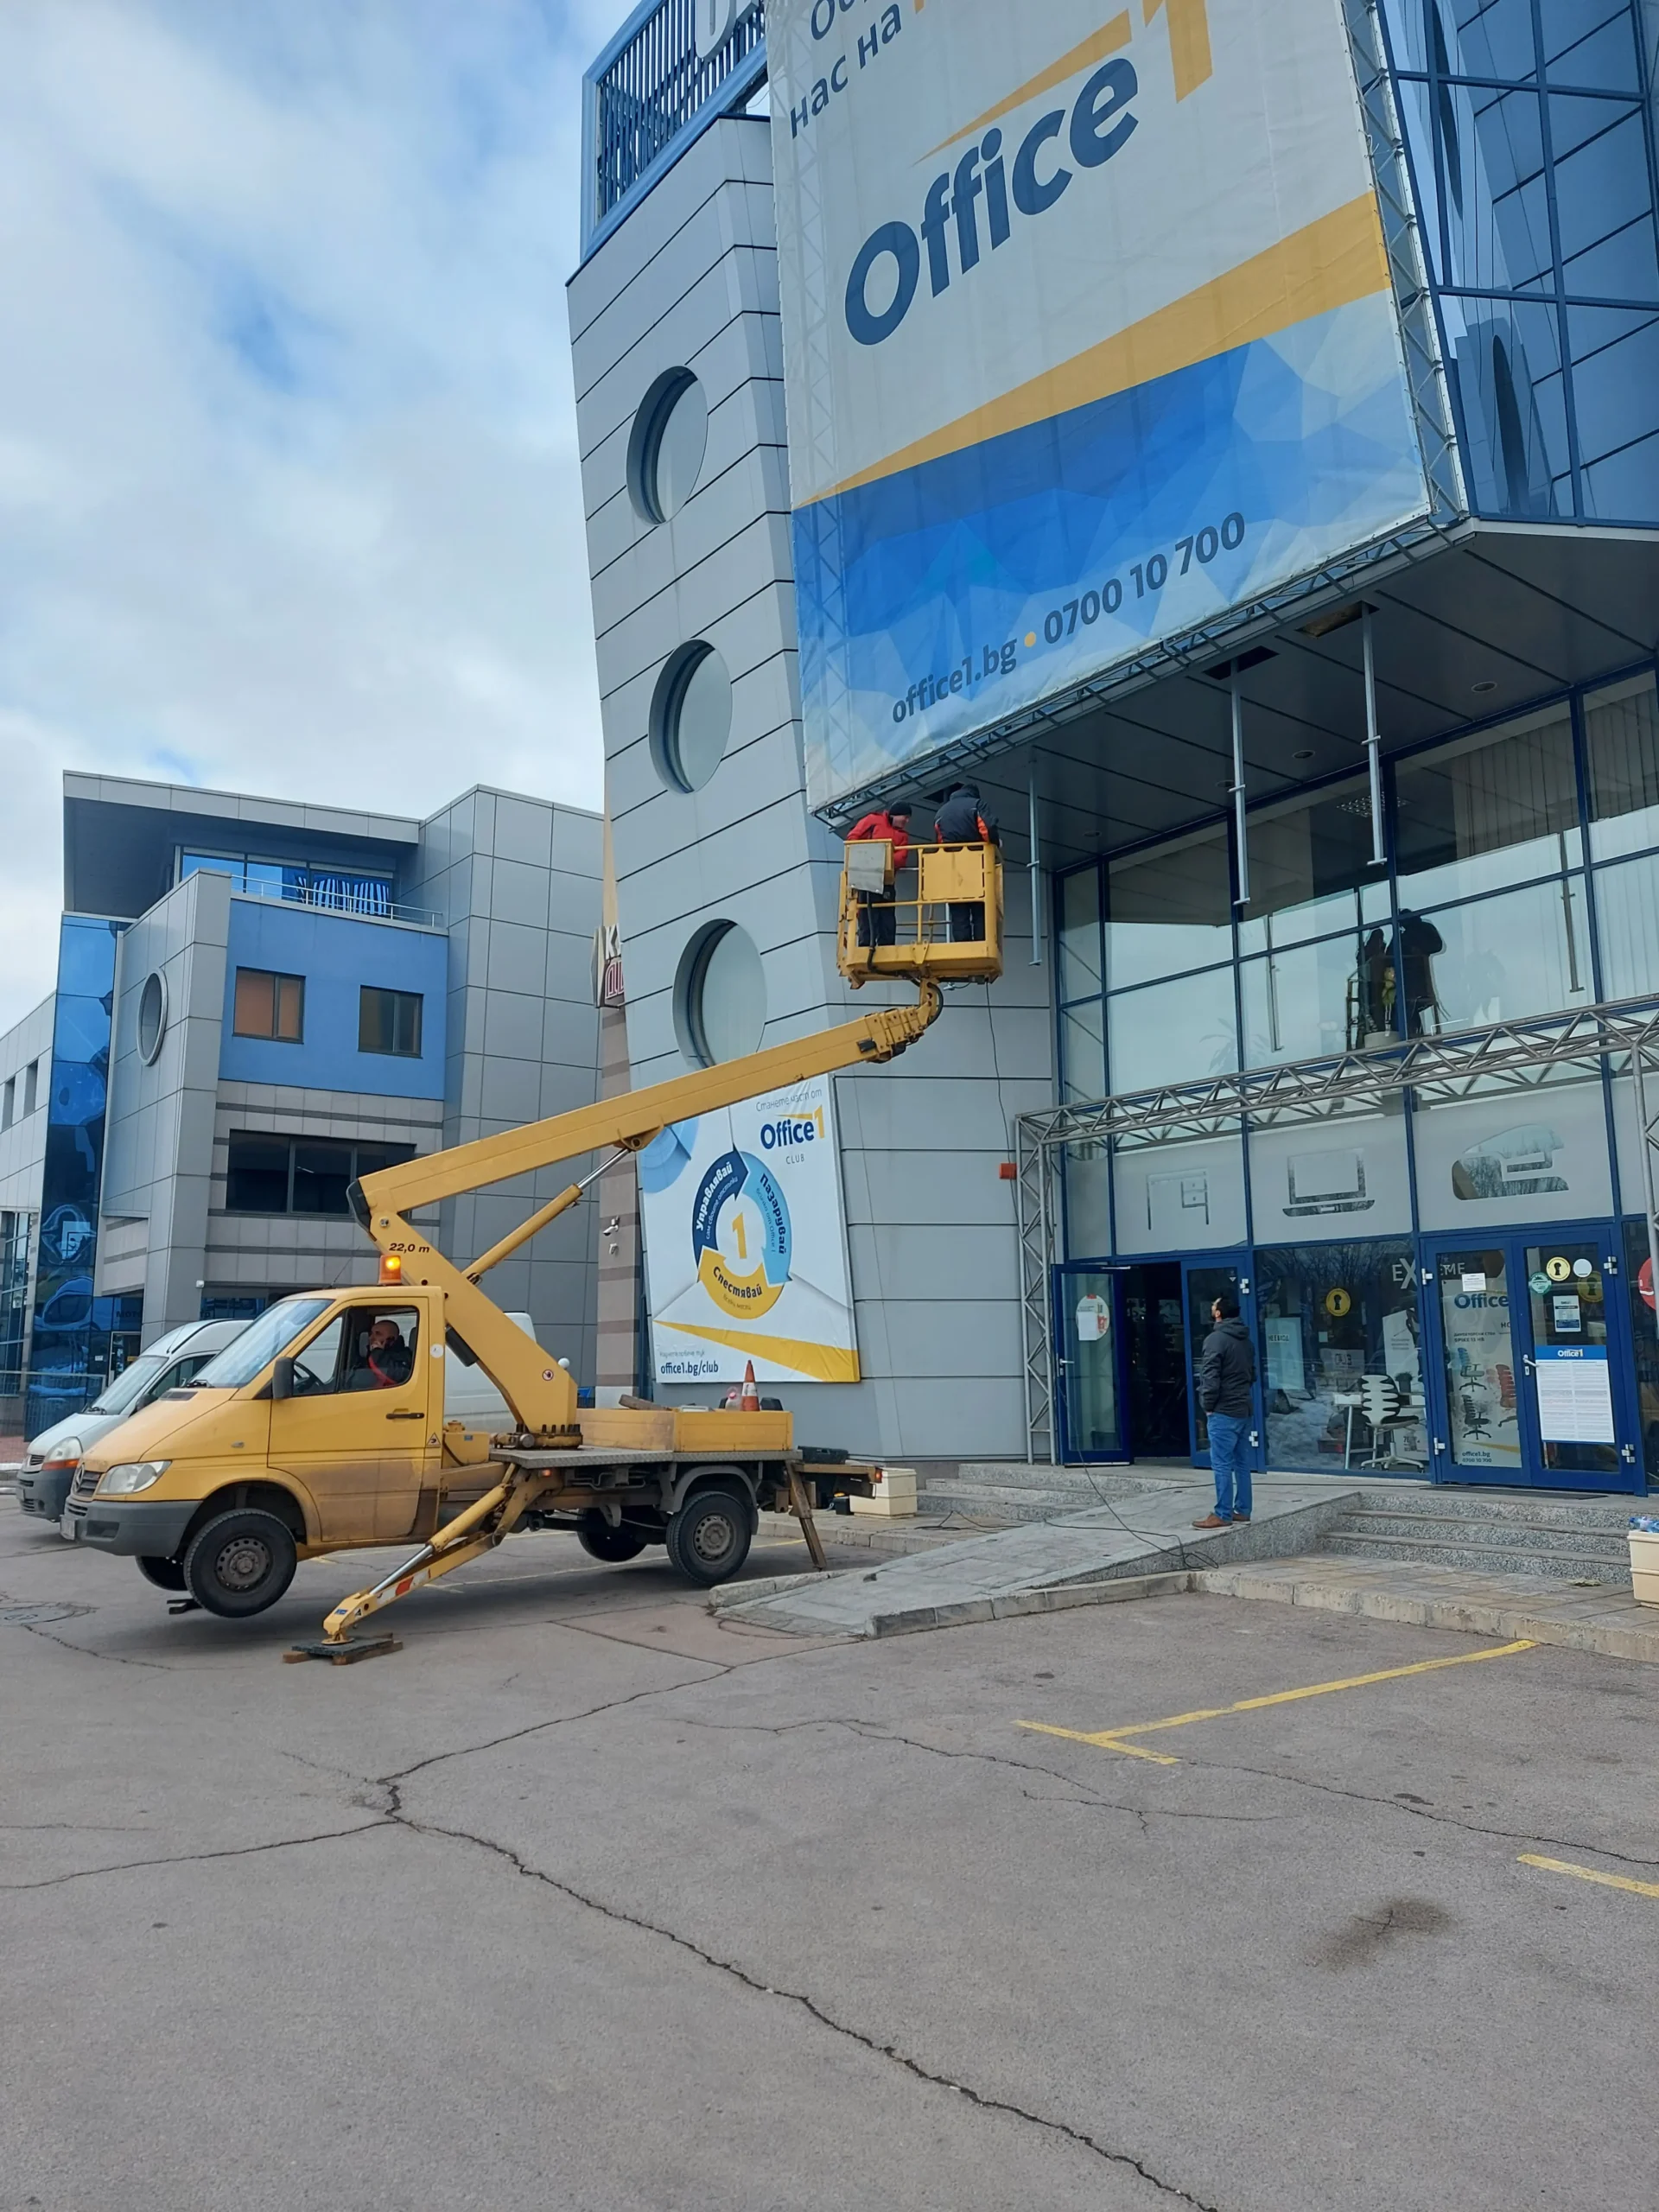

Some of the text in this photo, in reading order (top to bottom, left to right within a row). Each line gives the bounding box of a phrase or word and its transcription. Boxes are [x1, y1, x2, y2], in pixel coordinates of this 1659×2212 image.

[790, 3, 902, 139] нас на
[892, 512, 1245, 723] office1.bg 0700 10 700
[760, 1104, 824, 1149] Office1
[785, 1154, 804, 1164] CLUB
[696, 1161, 733, 1231] Управлявай
[760, 1173, 786, 1254] Пазарувай
[389, 1243, 416, 1254] 22,0
[732, 1211, 747, 1259] 1
[713, 1266, 762, 1299] Спестявай
[660, 1359, 719, 1376] office1.bg/club
